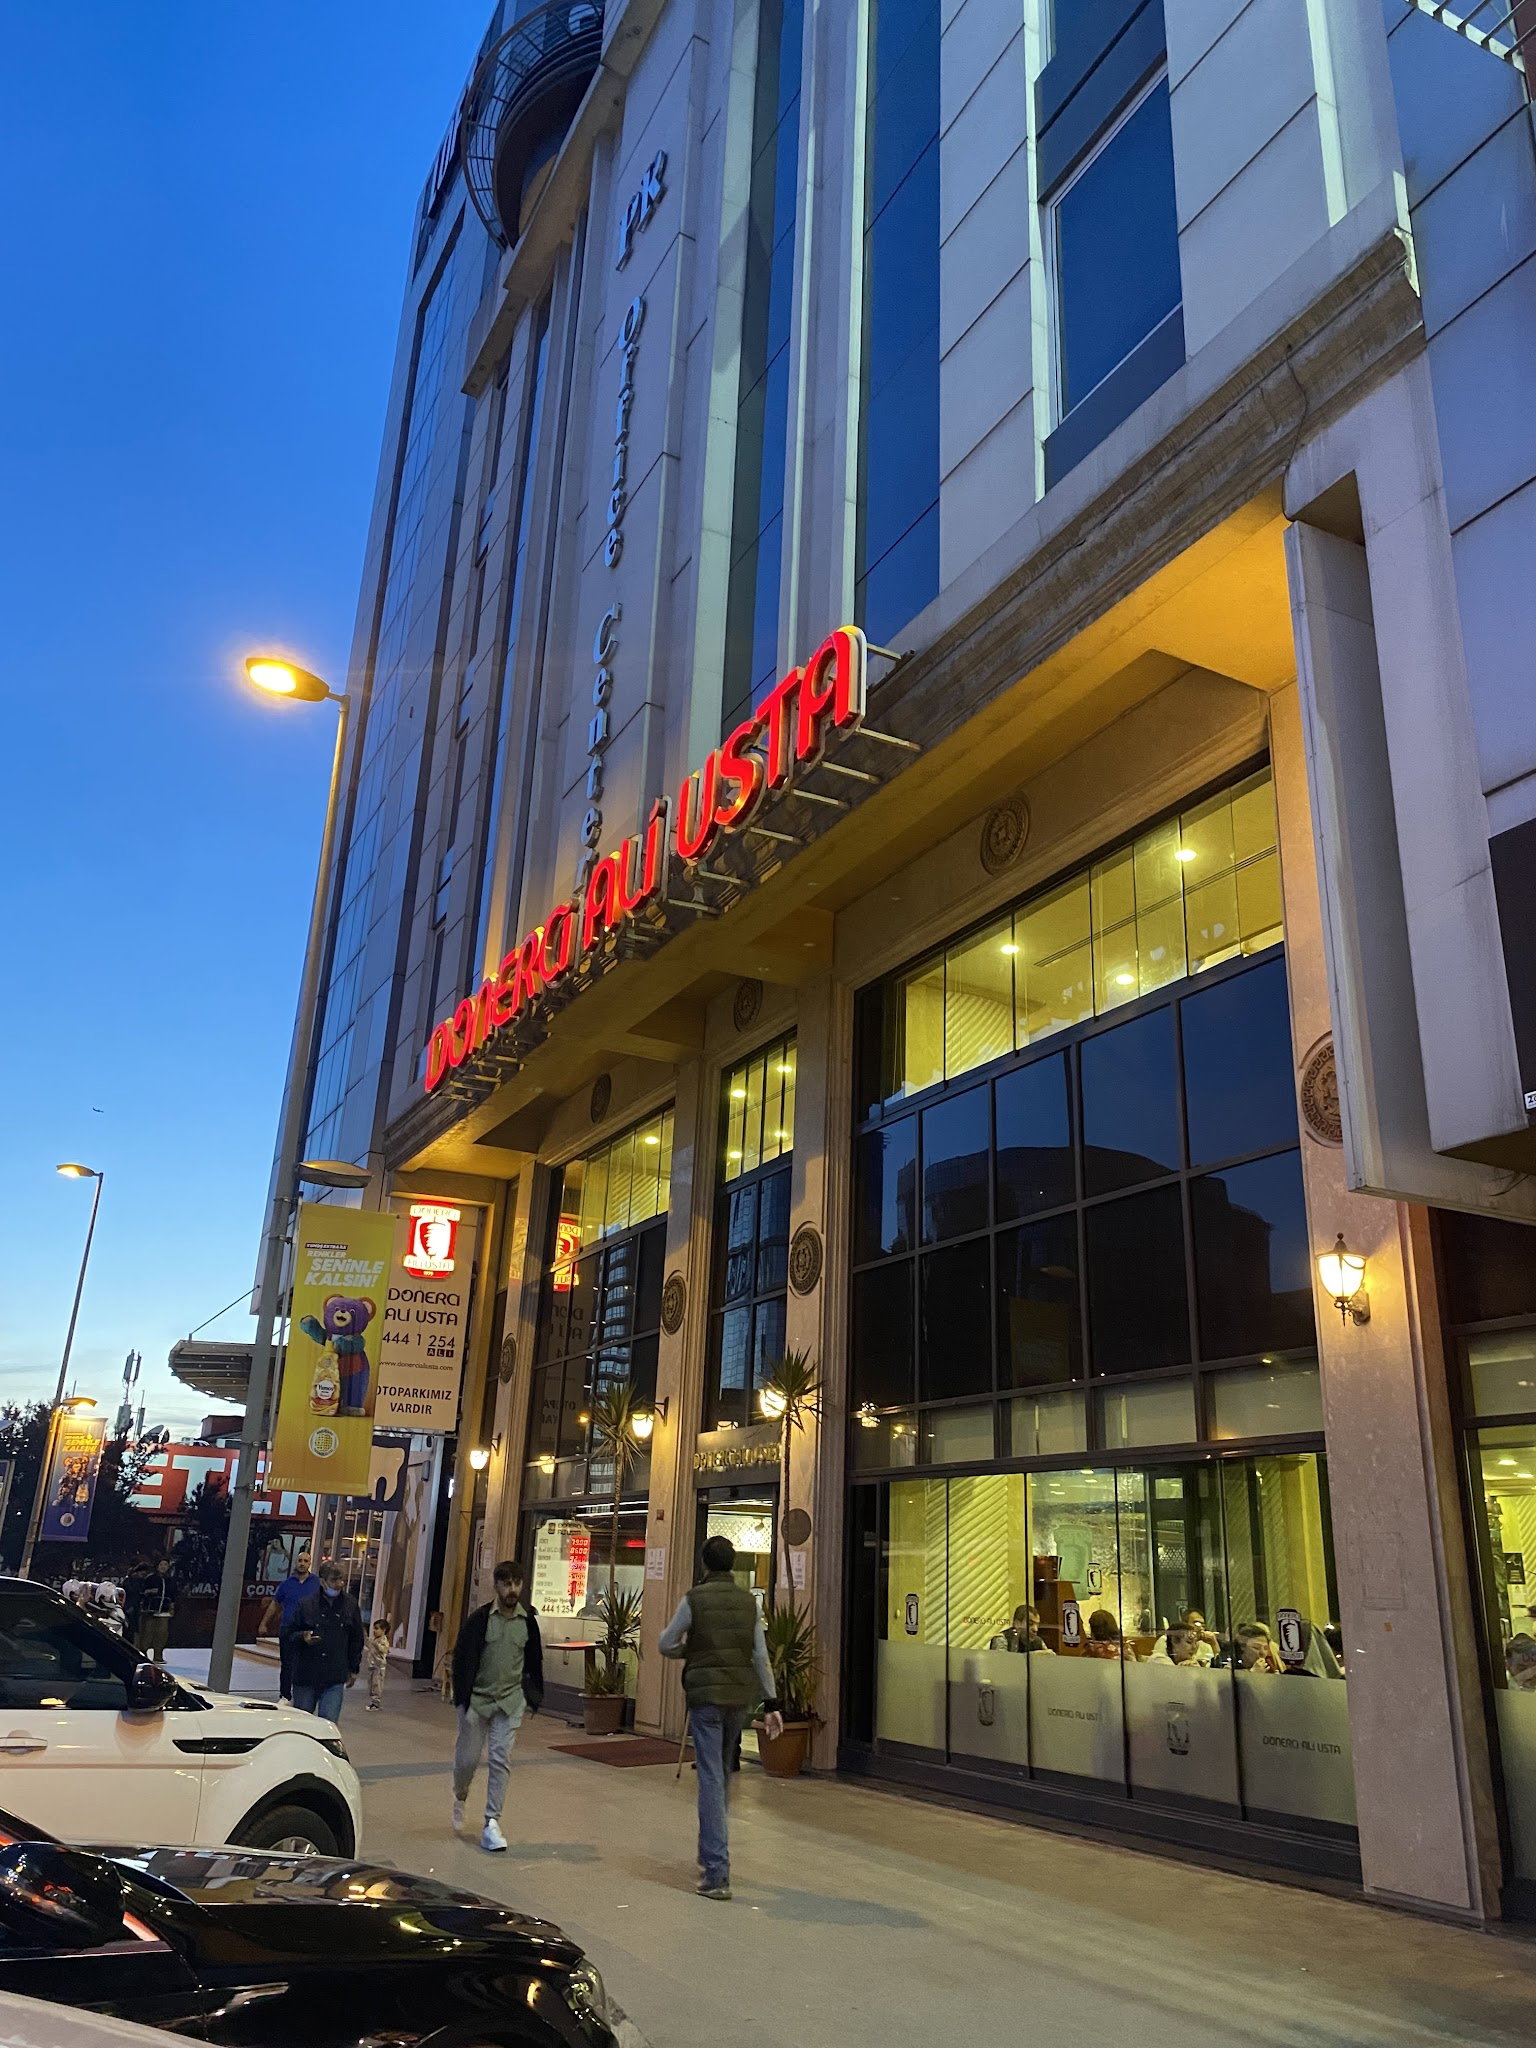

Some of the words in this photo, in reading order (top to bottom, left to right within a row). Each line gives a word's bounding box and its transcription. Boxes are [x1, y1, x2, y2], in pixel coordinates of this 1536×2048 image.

[604, 296, 648, 570] Office
[575, 602, 622, 895] Center
[676, 626, 866, 862] USTA
[307, 1250, 347, 1258] RENKLER
[304, 1272, 379, 1288] KALSIN!
[416, 1310, 458, 1326] USTA
[382, 1331, 410, 1344] 444
[417, 1333, 422, 1346] 1
[428, 1334, 455, 1348] 254
[390, 1402, 432, 1415] VARDIR
[1317, 1742, 1341, 1755] USTA
